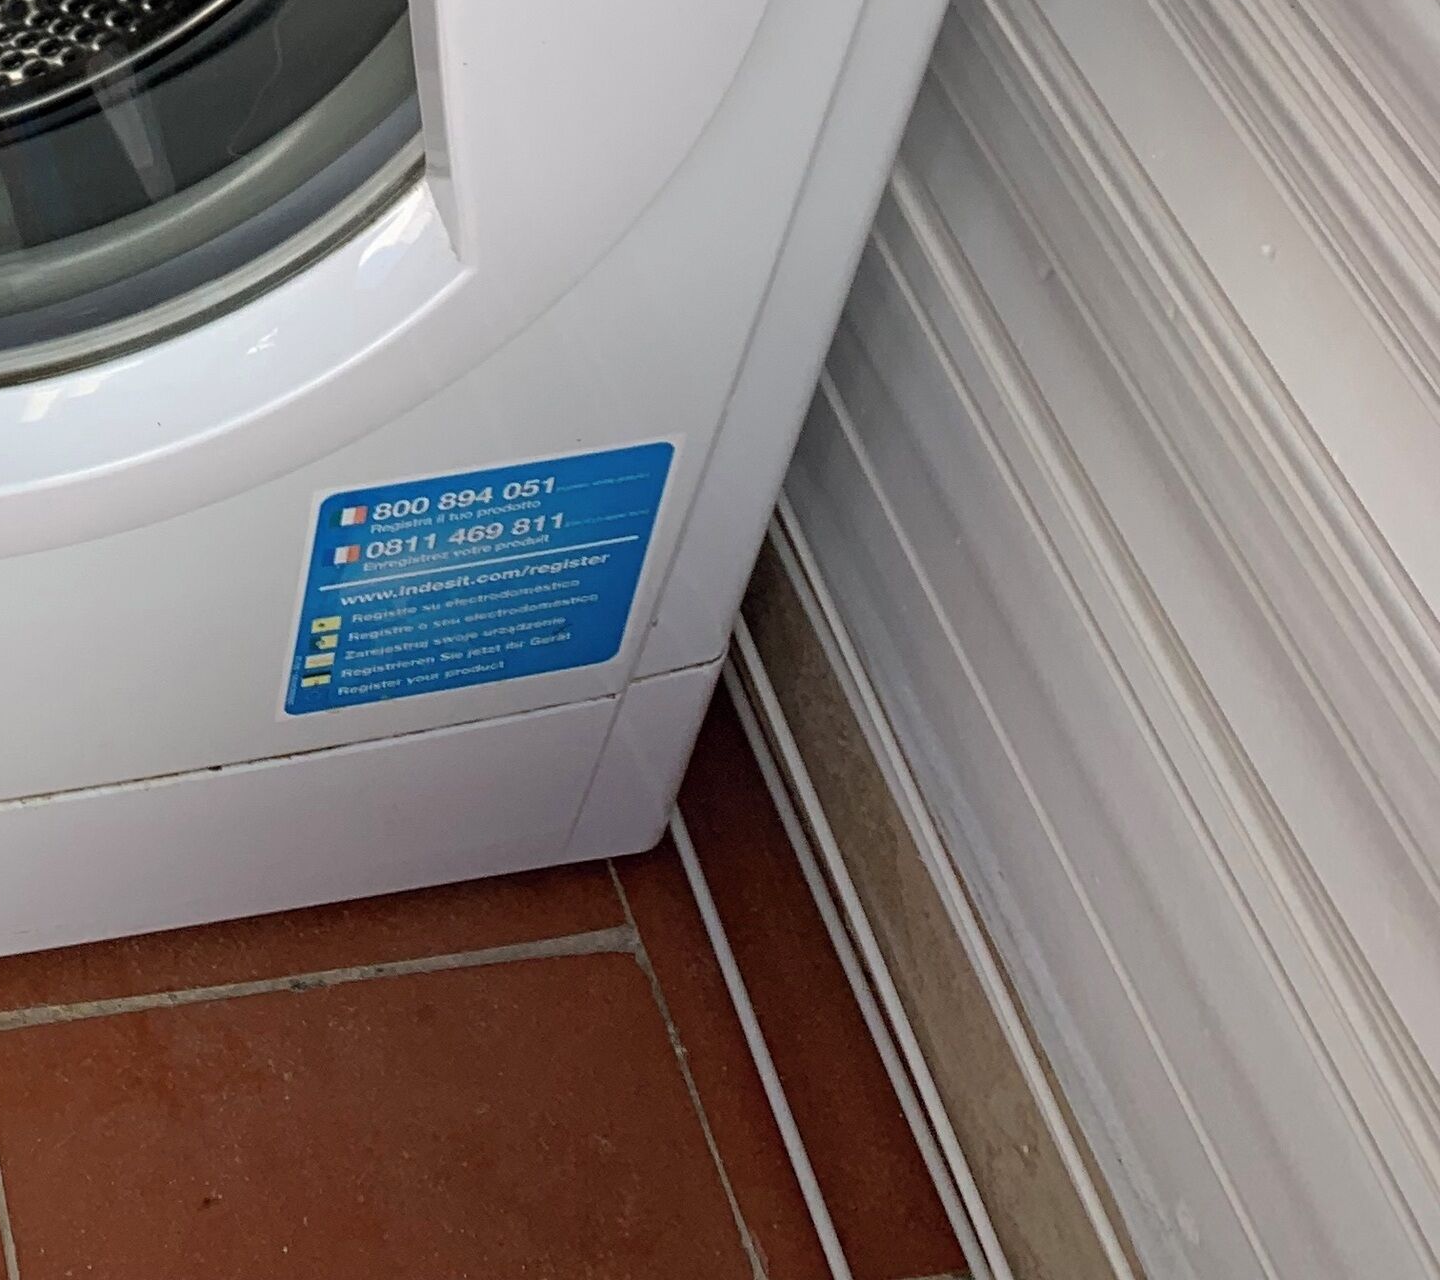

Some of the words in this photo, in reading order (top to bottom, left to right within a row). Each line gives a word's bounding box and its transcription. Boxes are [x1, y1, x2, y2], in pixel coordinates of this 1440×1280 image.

[372, 497, 430, 520] 800
[437, 486, 493, 511] 894
[502, 476, 554, 500] 051
[476, 499, 541, 519] prodotto
[366, 533, 436, 558] 0811
[449, 521, 503, 545] 469
[511, 513, 563, 536] 811
[341, 554, 610, 606] www.indesit.com/register
